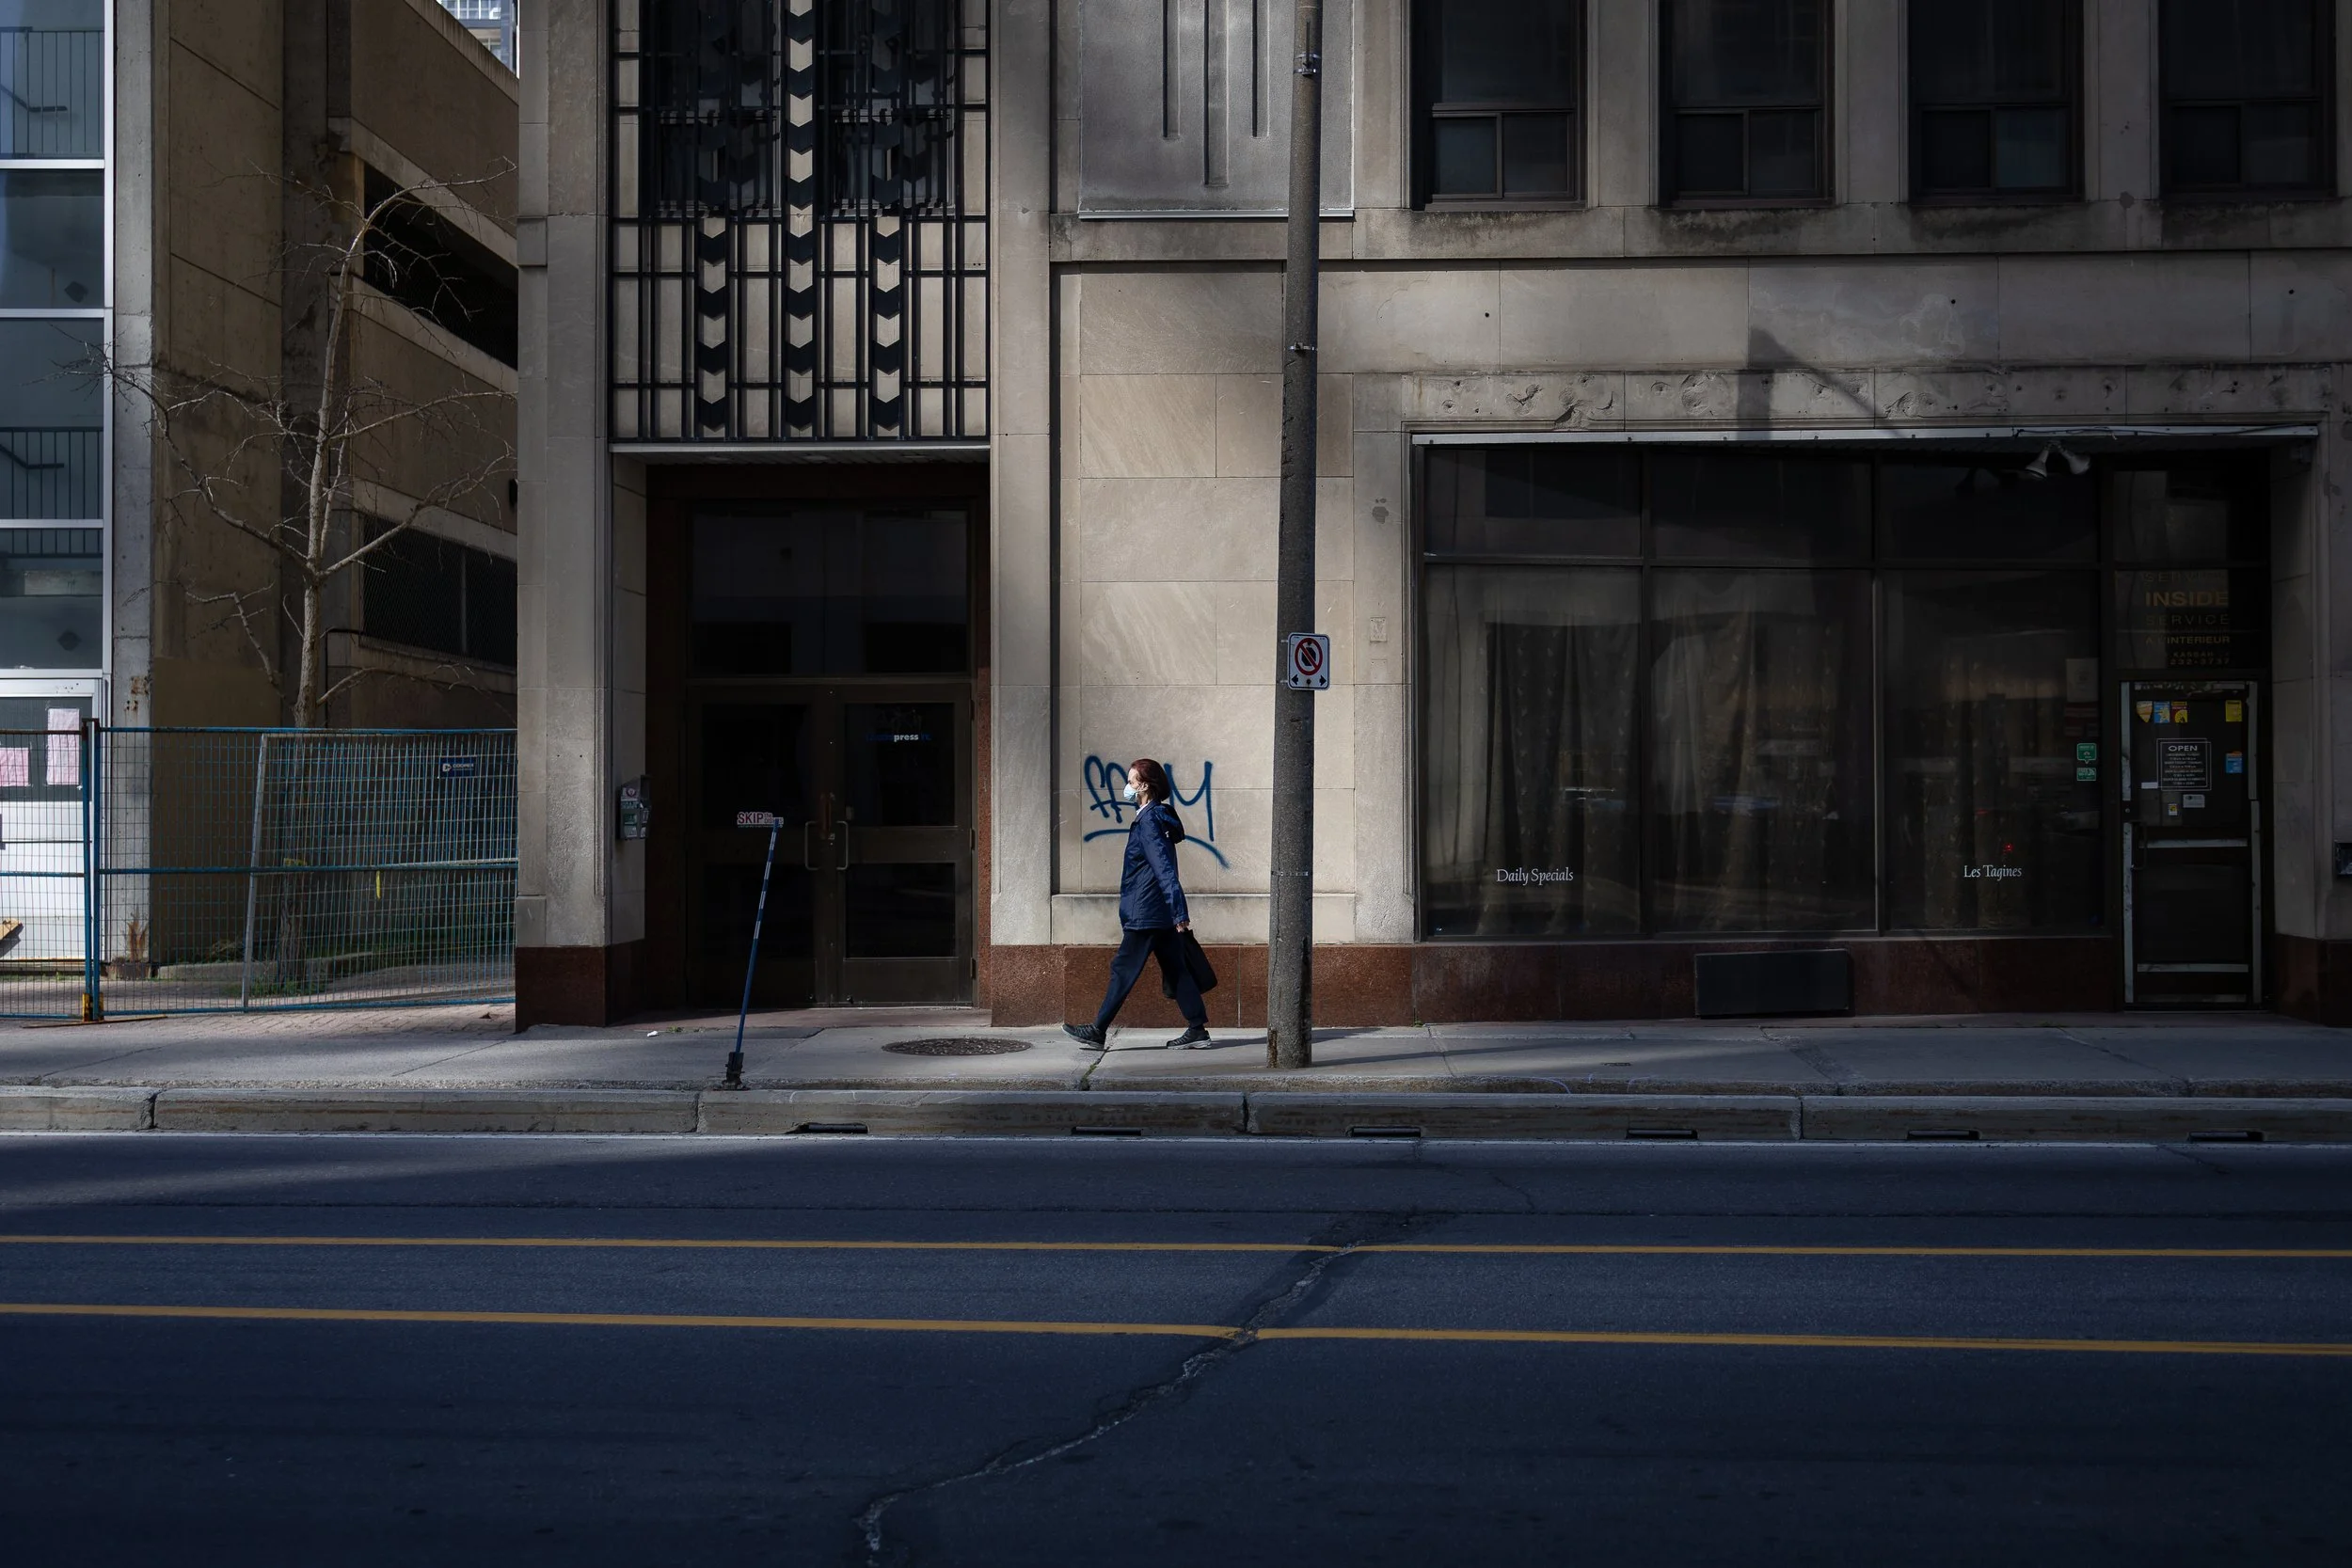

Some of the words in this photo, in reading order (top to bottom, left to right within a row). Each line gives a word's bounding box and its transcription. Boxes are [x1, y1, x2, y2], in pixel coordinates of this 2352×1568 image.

[2146, 592, 2229, 607] INSIDE
[2145, 613, 2230, 626] SERVICE
[739, 812, 763, 823] SKIP
[1497, 867, 1529, 885] Daily
[1532, 867, 1574, 885] Specials
[1964, 865, 1981, 878] Les
[1983, 864, 2022, 880] Tagines
